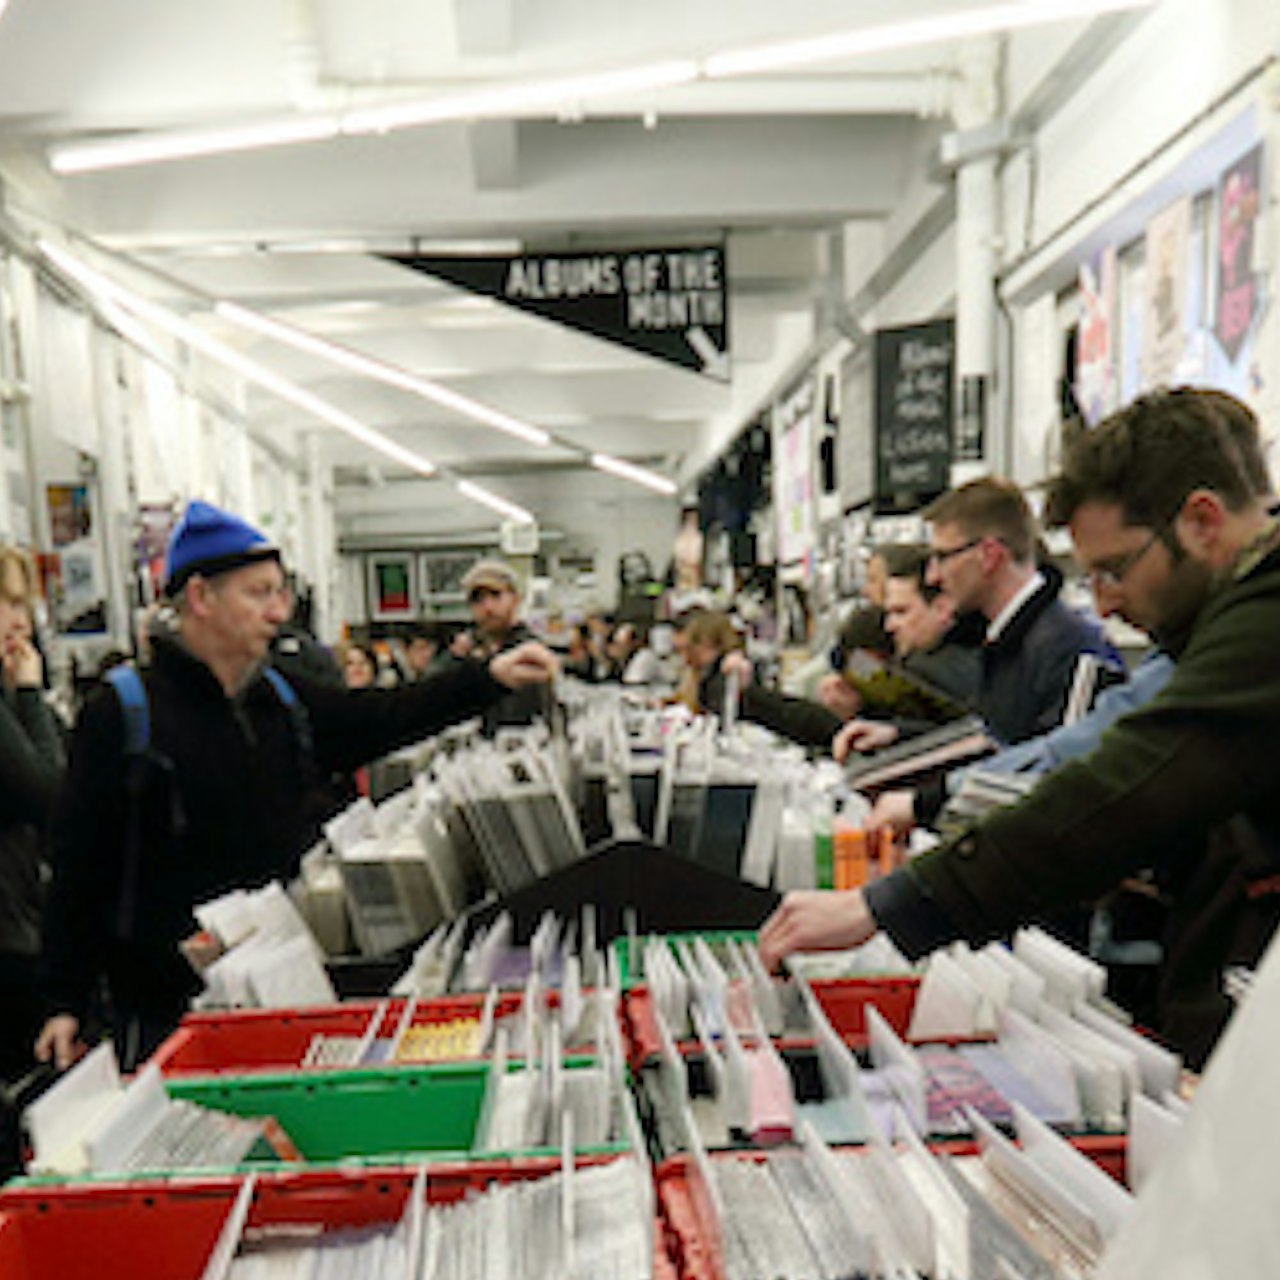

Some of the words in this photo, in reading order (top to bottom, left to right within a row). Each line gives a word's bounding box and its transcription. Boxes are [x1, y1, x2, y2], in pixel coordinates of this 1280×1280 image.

[505, 256, 620, 299] ALBUMS
[623, 254, 663, 292] OF
[665, 251, 719, 290] THE
[628, 291, 724, 330] MONTH
